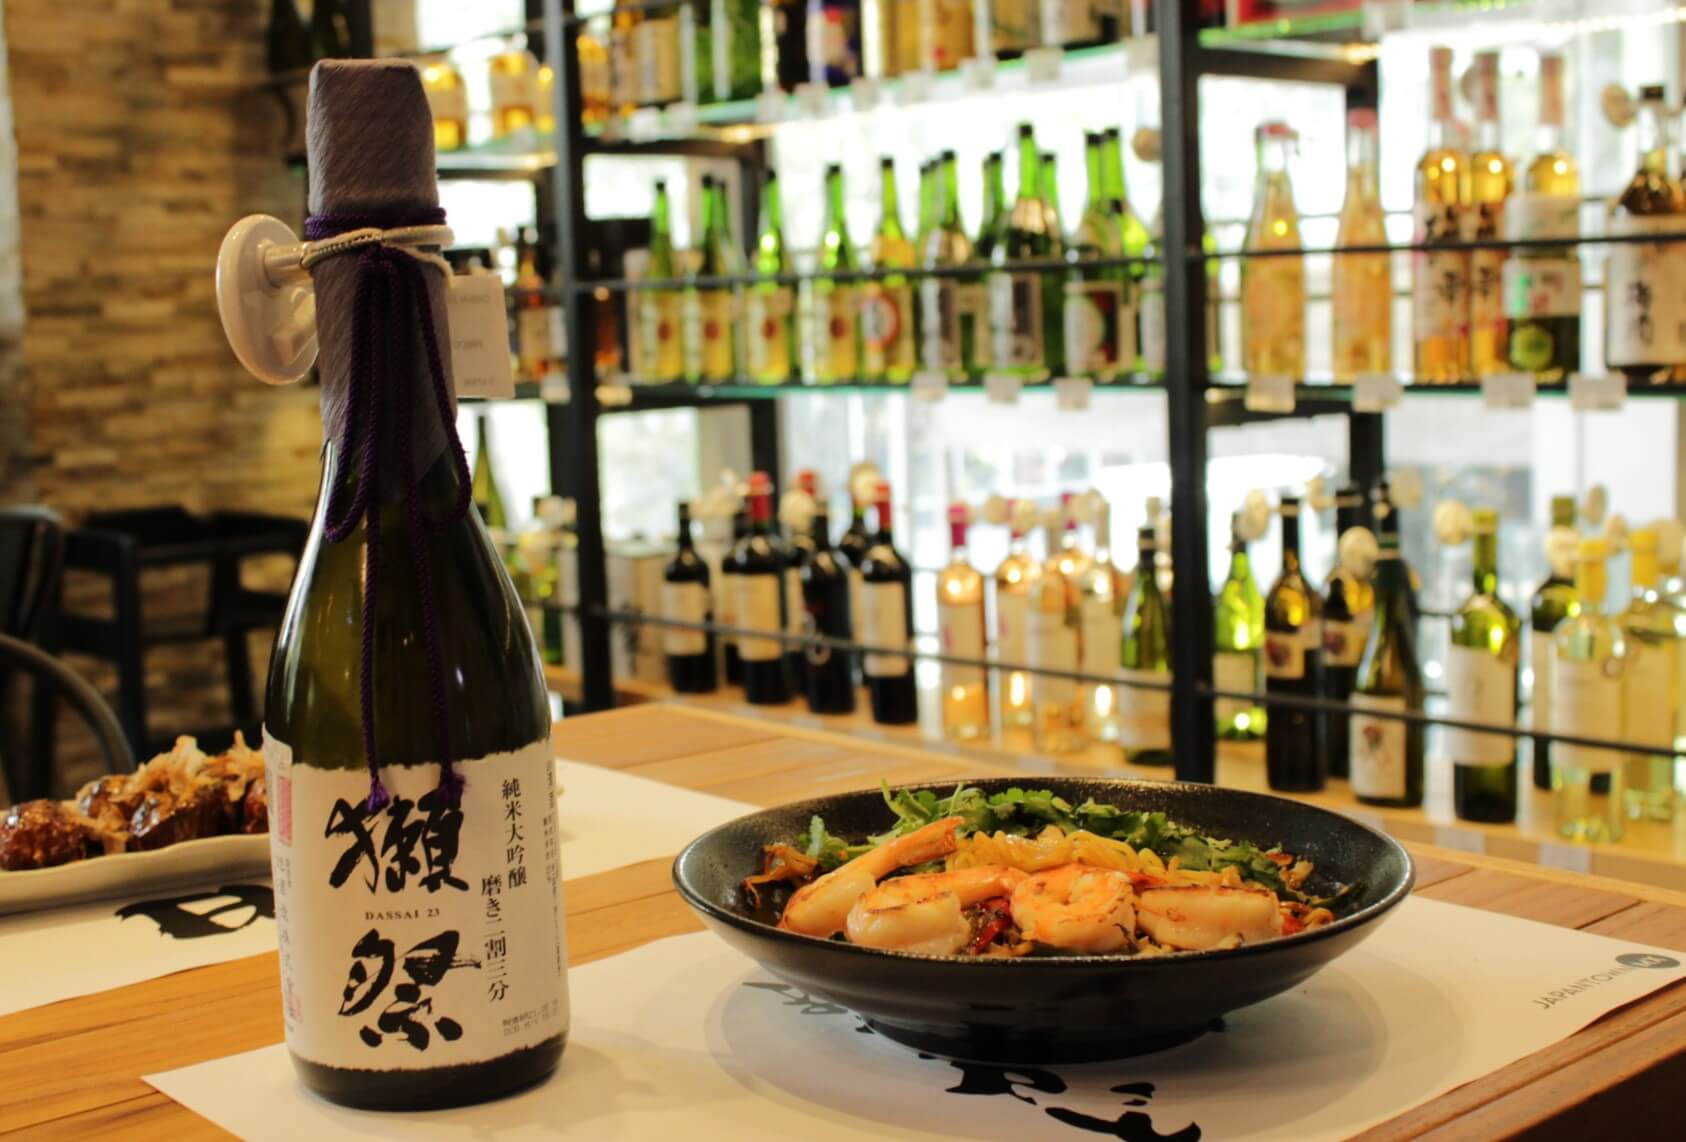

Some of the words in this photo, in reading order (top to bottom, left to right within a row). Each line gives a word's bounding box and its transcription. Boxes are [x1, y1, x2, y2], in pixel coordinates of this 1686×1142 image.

[365, 909, 419, 921] DASSAI
[427, 907, 440, 918] 23
[481, 874, 509, 1002] 磨き二割三分
